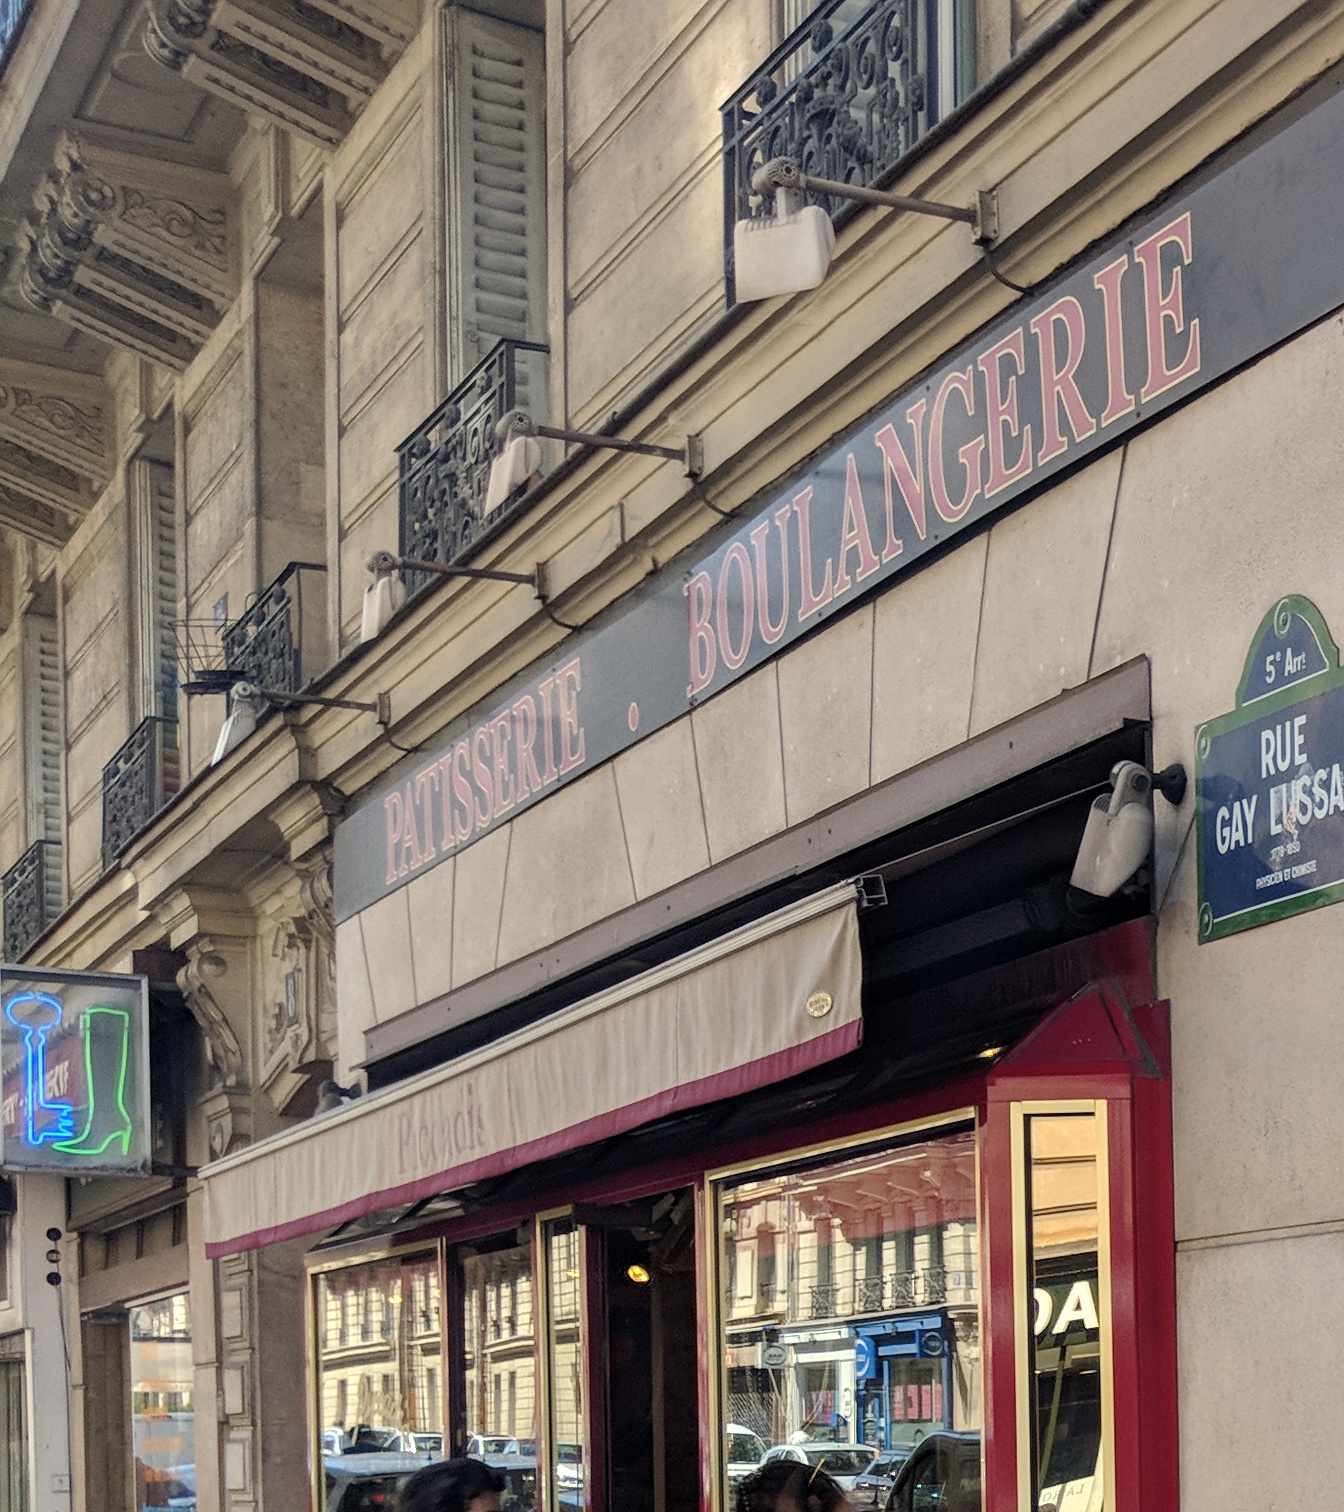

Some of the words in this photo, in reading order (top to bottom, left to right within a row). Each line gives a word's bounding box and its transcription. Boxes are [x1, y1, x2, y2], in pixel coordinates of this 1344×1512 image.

[384, 657, 586, 886] PATISSERIE
[682, 210, 1203, 702] BOULANGERIE
[1260, 714, 1308, 779] RUE
[1216, 794, 1258, 855] GAY
